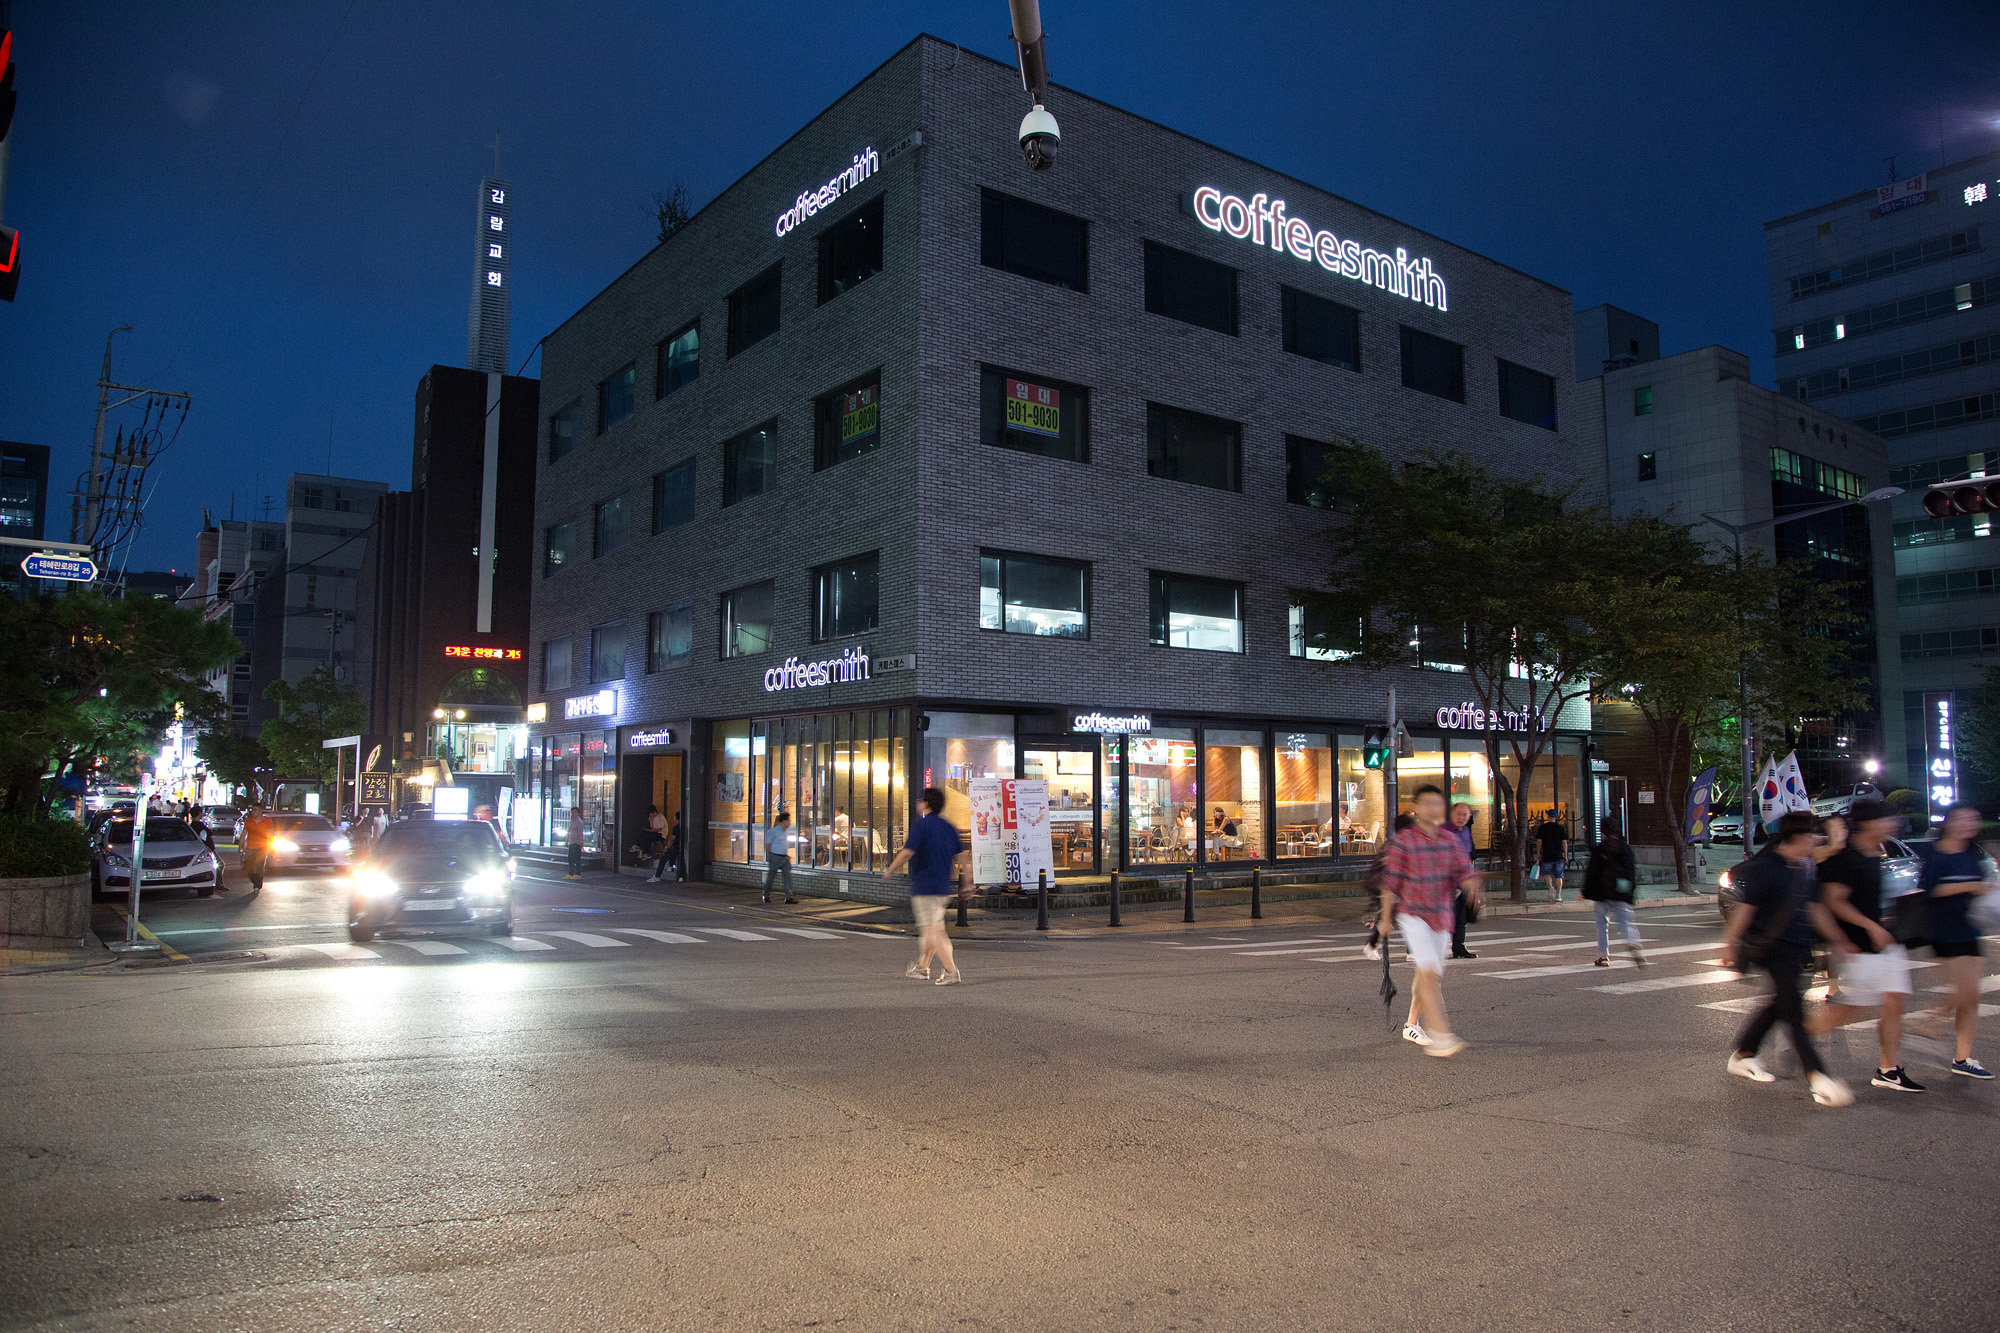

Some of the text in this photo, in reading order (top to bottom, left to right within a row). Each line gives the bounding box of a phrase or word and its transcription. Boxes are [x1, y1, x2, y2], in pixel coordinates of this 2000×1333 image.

[776, 146, 879, 237] coffeesmith
[1194, 186, 1448, 311] coffeesmith
[843, 404, 876, 437] 501-9030
[1008, 400, 1058, 430] 501-9030
[39, 560, 80, 572] 테헤란로8길
[39, 568, 66, 577] Teheran-ro
[81, 567, 91, 575] 25
[764, 645, 870, 692] coffeesmith
[1074, 712, 1151, 731] coffeesmith
[630, 728, 671, 748] coffeesmith
[1005, 854, 1019, 869] 50
[1006, 869, 1021, 883] 90
